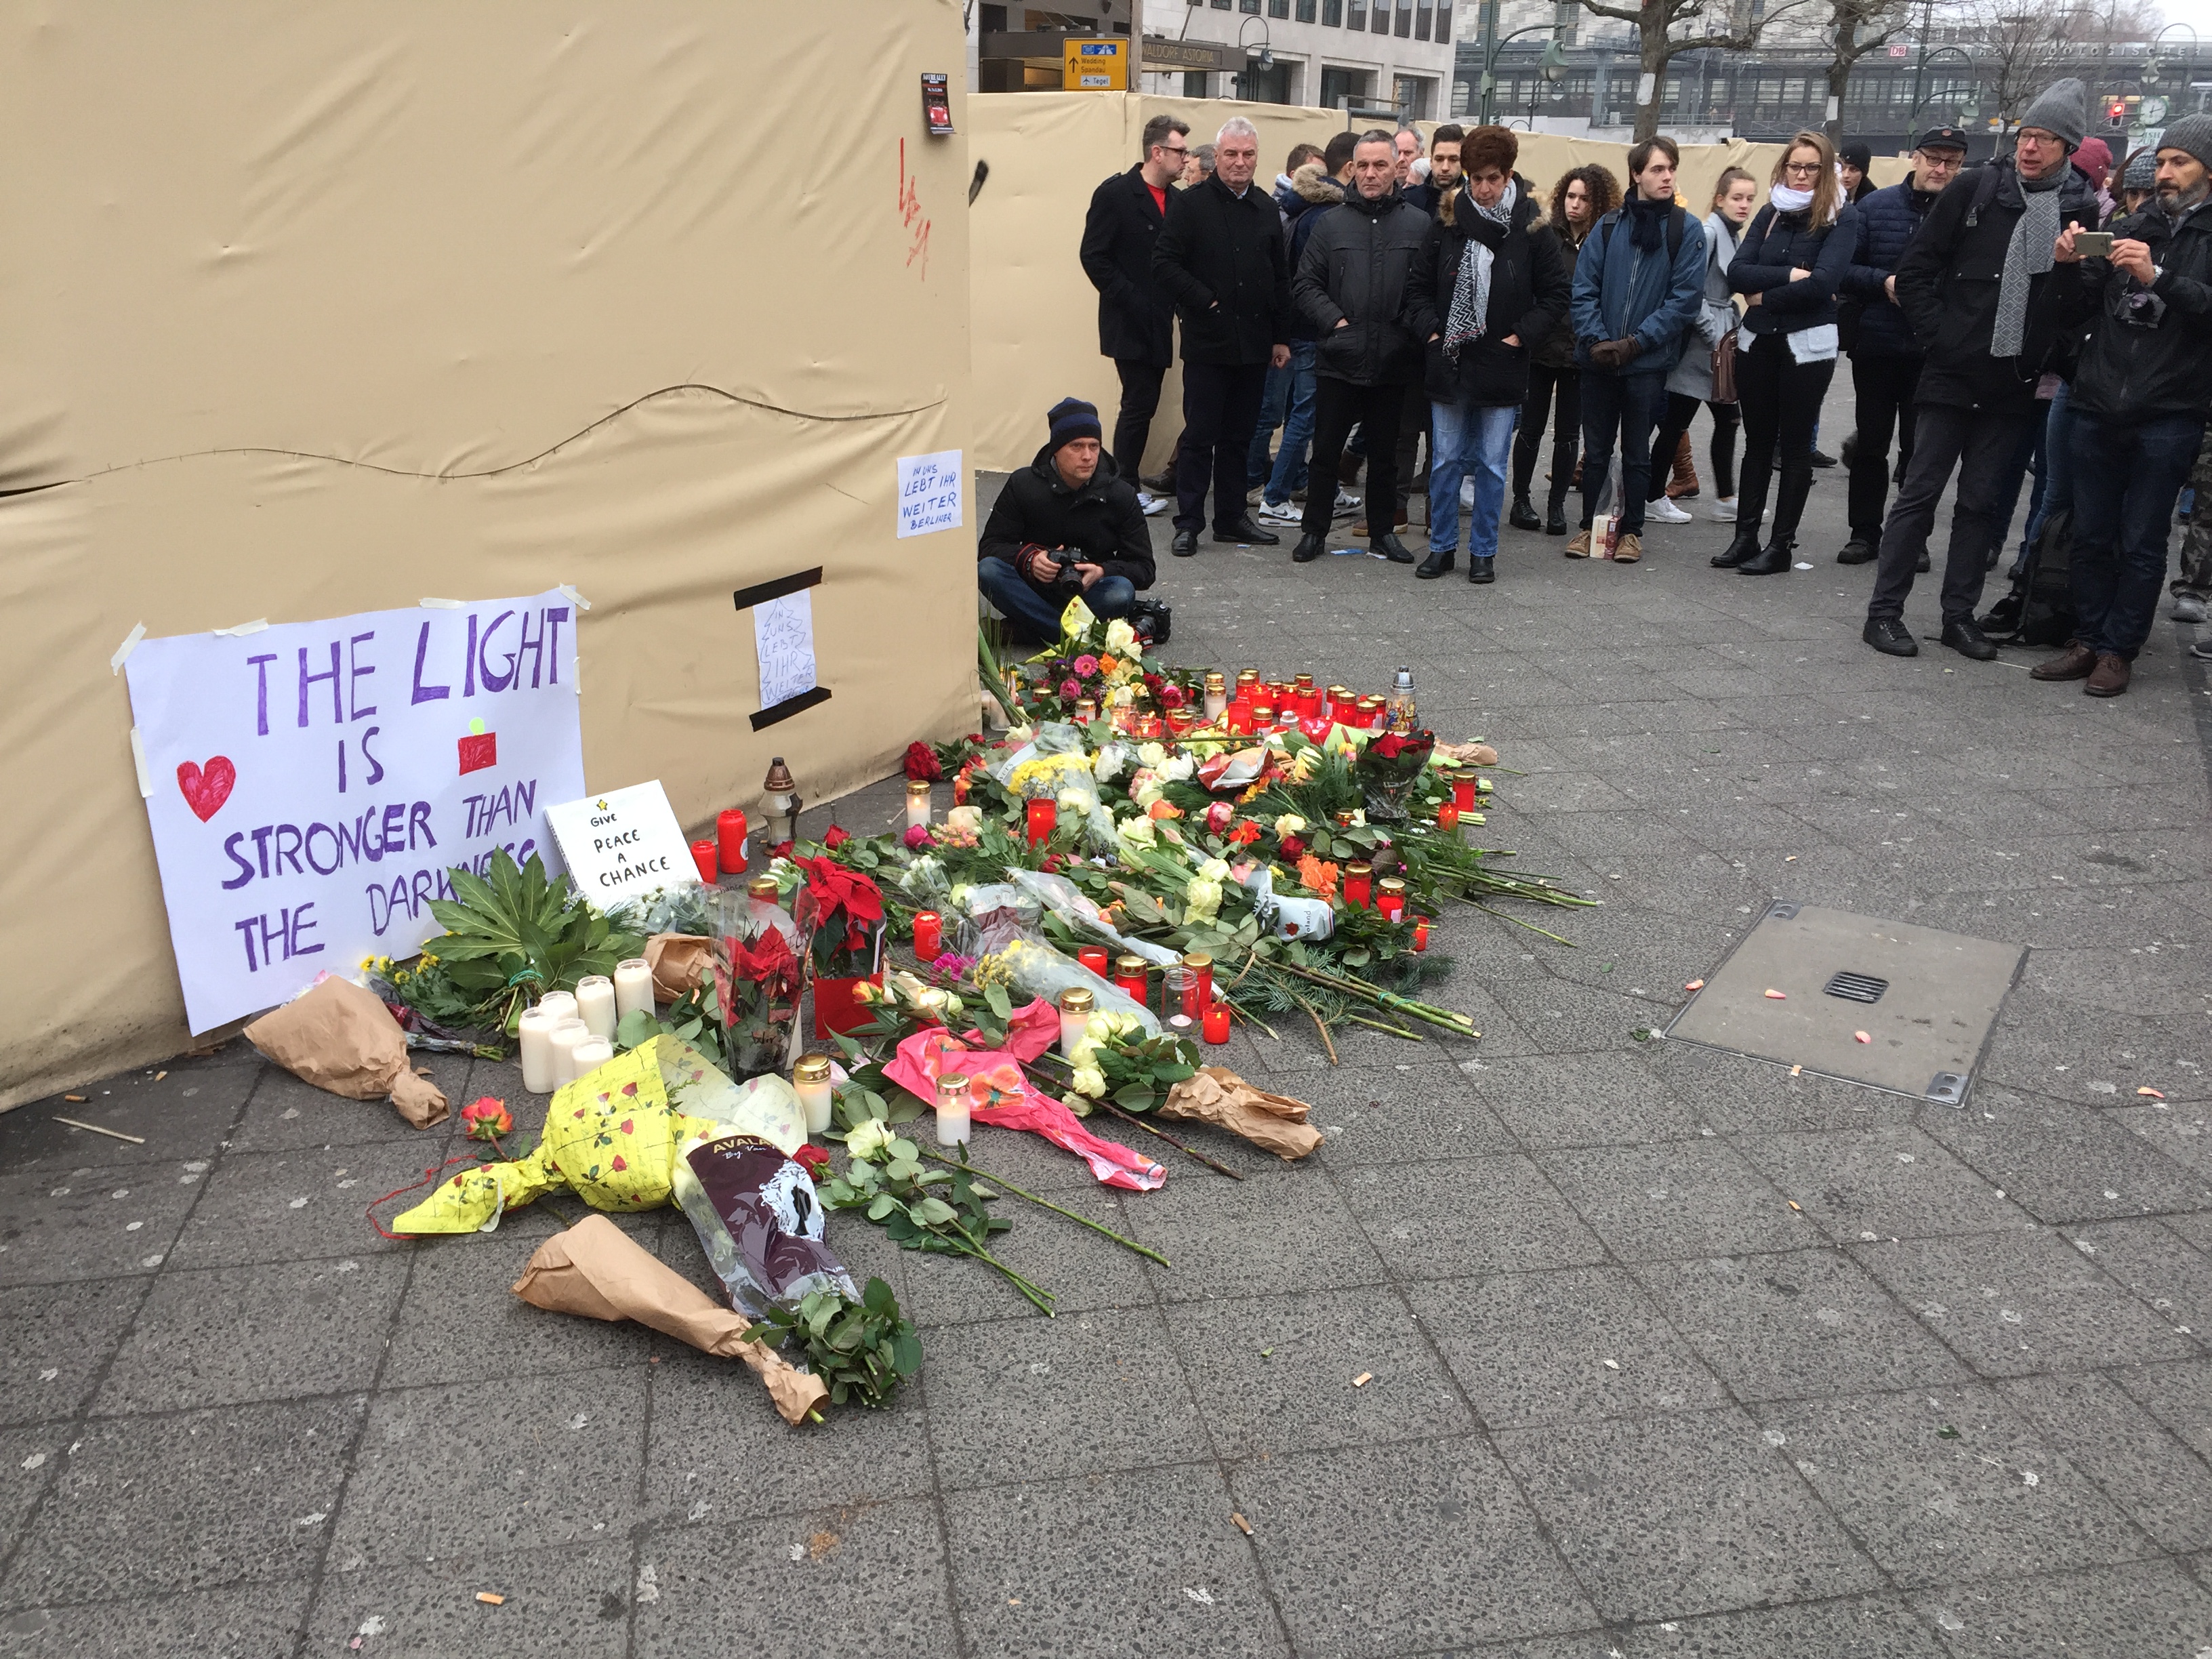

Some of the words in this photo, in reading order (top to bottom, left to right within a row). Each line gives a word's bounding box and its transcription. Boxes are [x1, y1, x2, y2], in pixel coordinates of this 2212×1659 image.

[1183, 49, 1214, 63] ASTORIA
[1891, 46, 1907, 56] DB
[1081, 58, 1106, 66] Wedding
[1093, 77, 1108, 85] Tegel
[913, 466, 922, 476] IN
[923, 464, 938, 476] UNS
[905, 476, 936, 497] LEBT
[939, 472, 956, 488] IHR
[903, 491, 957, 518] WEITER
[910, 513, 952, 530] BERLINER
[775, 610, 783, 619] IN
[771, 621, 793, 636] UNS
[765, 634, 798, 657] LEBT
[247, 630, 377, 736] THE
[411, 608, 569, 706] LIGHT
[775, 651, 800, 678] IHR
[766, 667, 813, 701] WEITER
[338, 726, 384, 793] IS
[590, 813, 617, 827] GIVE
[221, 801, 437, 890] STRONGER
[462, 779, 537, 839] THAN
[594, 829, 640, 853] PEACE
[617, 853, 627, 863] A
[599, 856, 670, 887] CHANCE
[235, 902, 325, 972] THE
[365, 838, 535, 937] DARKNES
[713, 1138, 774, 1153] AVALA
[722, 1151, 743, 1160] By
